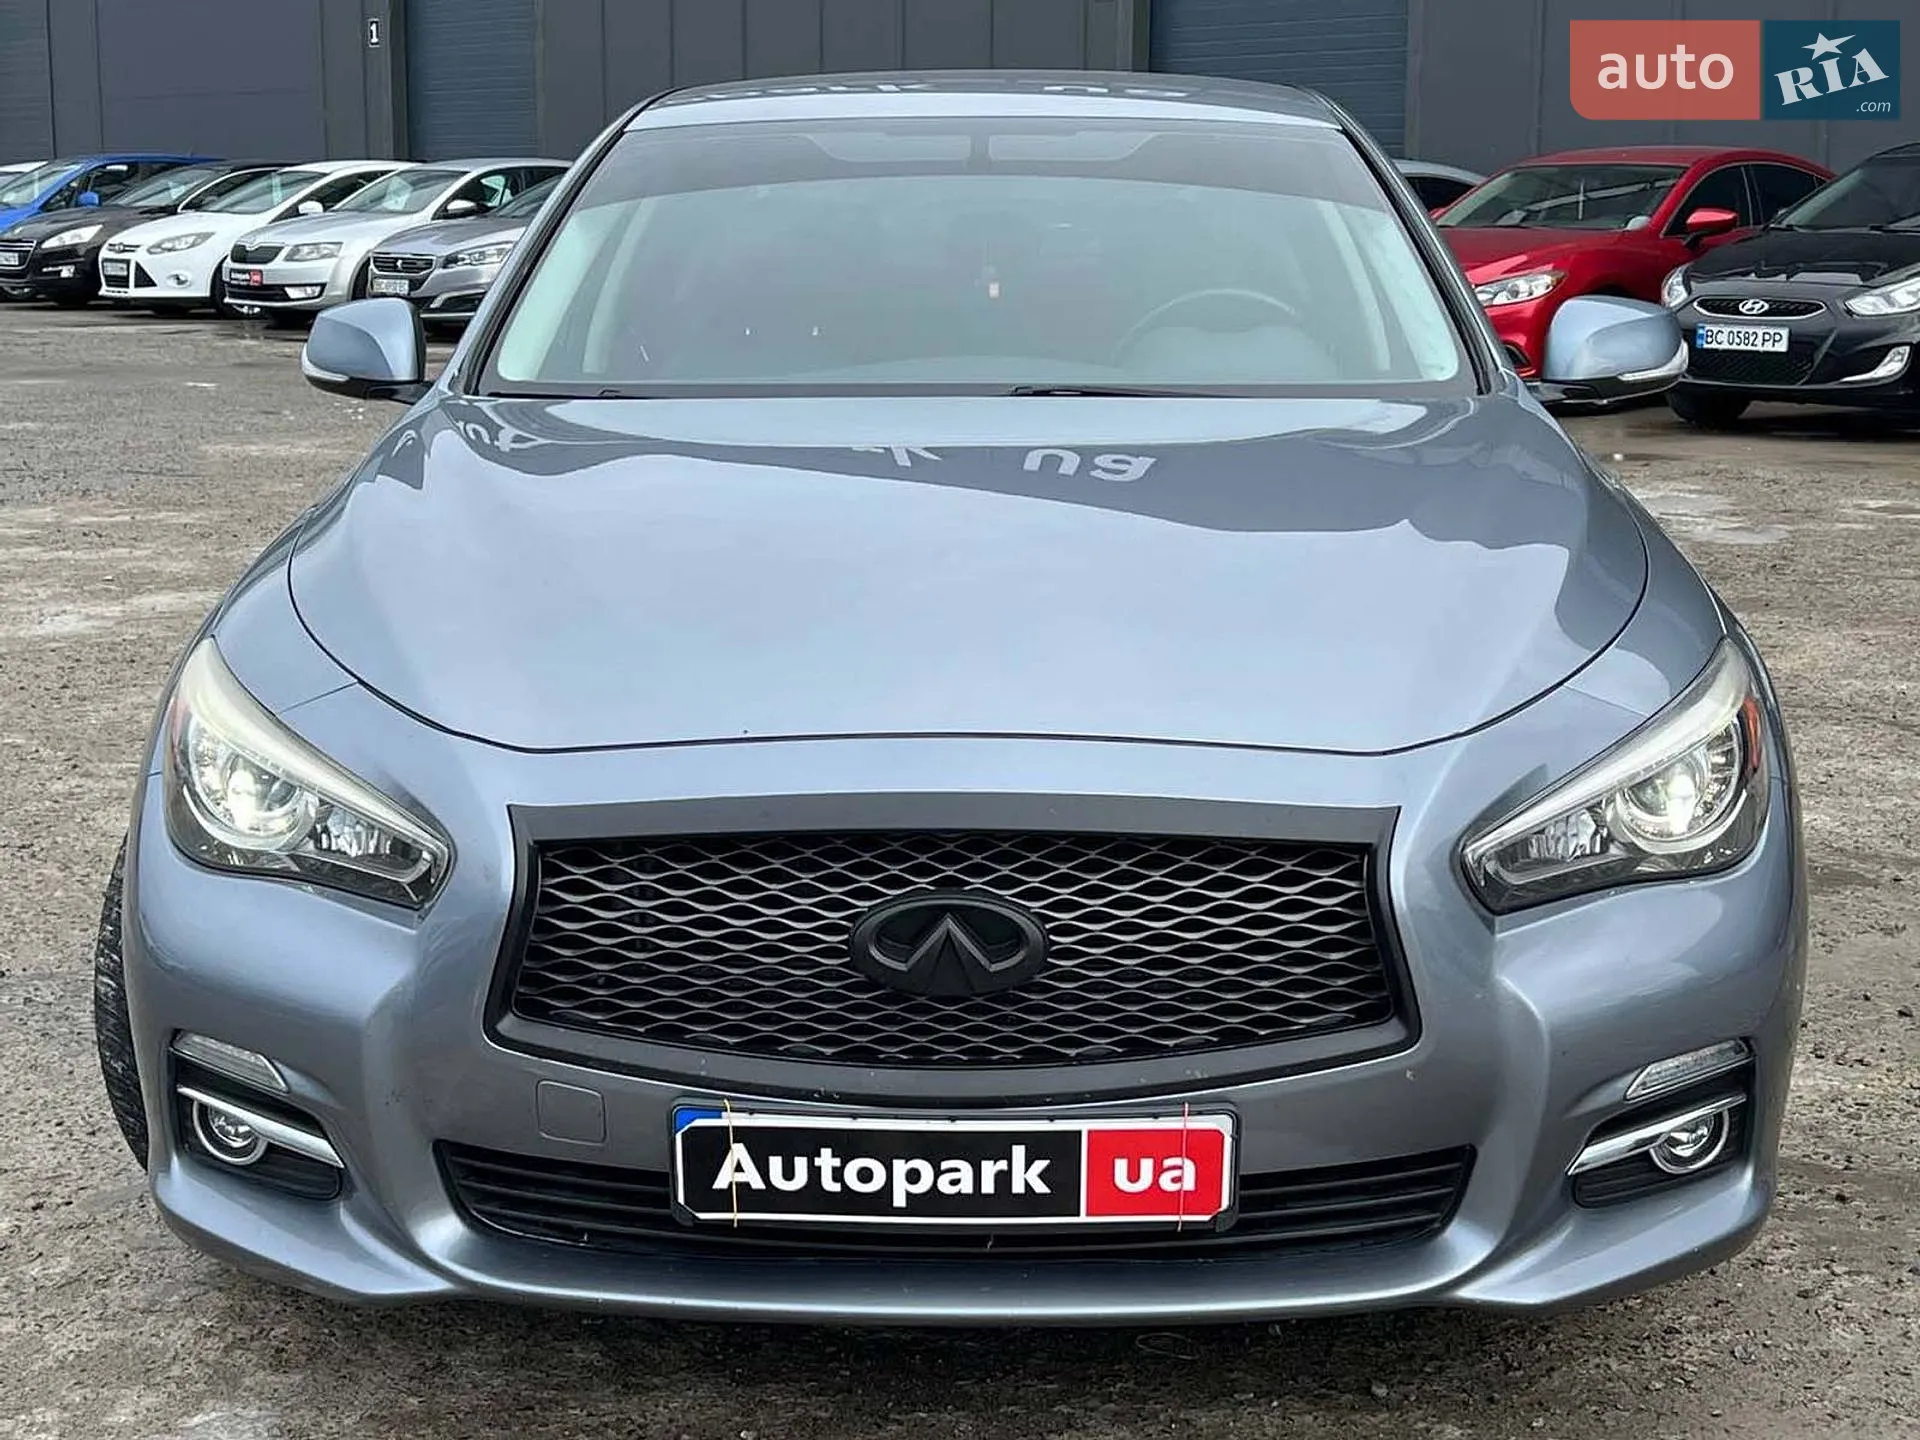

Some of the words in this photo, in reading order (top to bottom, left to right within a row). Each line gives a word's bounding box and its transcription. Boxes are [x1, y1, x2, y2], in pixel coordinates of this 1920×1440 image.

[370, 22, 379, 43] 1
[1705, 328, 1724, 345] BC
[1727, 330, 1759, 347] 0582
[1761, 331, 1783, 348] PP
[712, 1142, 1052, 1208] Autopark
[1112, 1154, 1196, 1193] ua
